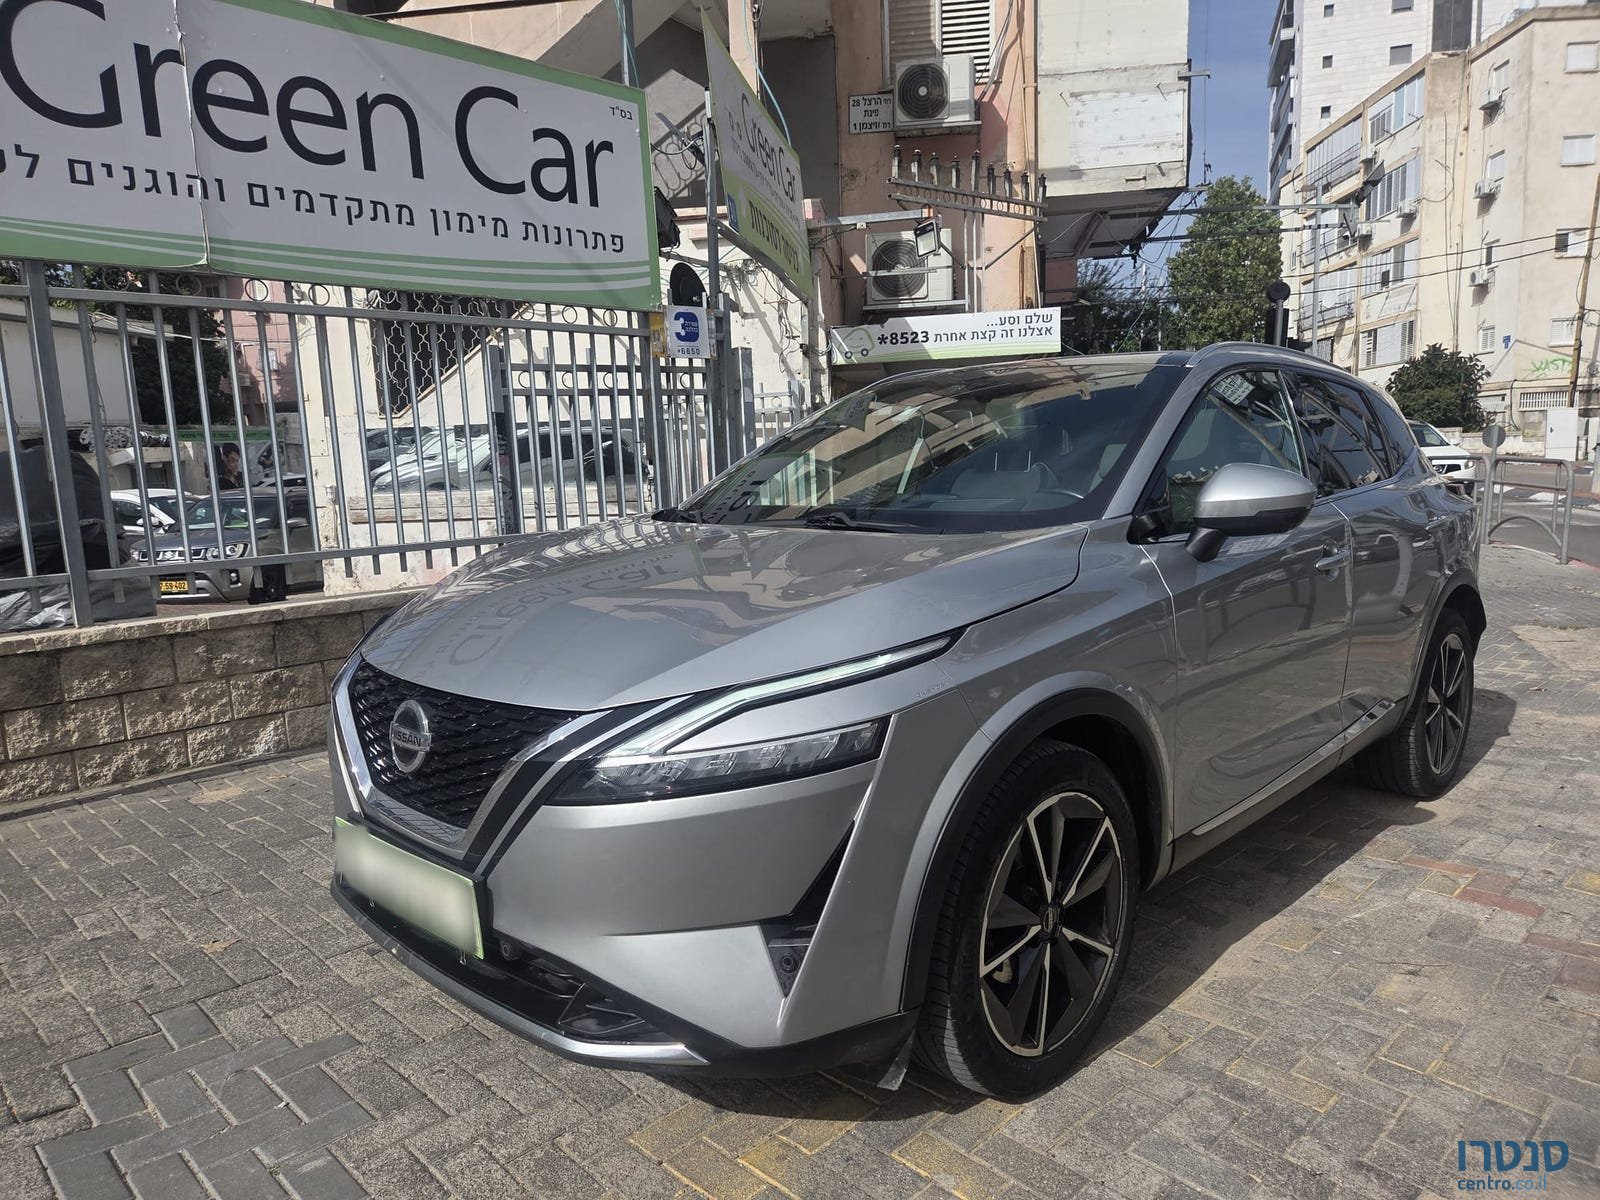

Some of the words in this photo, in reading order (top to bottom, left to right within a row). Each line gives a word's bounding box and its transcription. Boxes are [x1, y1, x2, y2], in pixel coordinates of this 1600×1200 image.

[0, 0, 425, 179] Green
[455, 86, 614, 208] Car
[851, 99, 861, 107] 28
[862, 96, 882, 106] הרצל
[609, 105, 633, 120] בס"ד
[863, 109, 879, 118] פינת
[853, 122, 857, 131] 1
[741, 92, 781, 186] Green
[67, 158, 226, 202] והוגנים
[247, 182, 415, 226] מתקדמים
[430, 208, 509, 238] מימון
[522, 221, 624, 253] פתרונות
[1025, 312, 1053, 324] שלם
[934, 331, 967, 342] אחרת
[971, 329, 996, 342] קצת
[1001, 329, 1014, 338] זה
[1018, 325, 1053, 338] אצלנו
